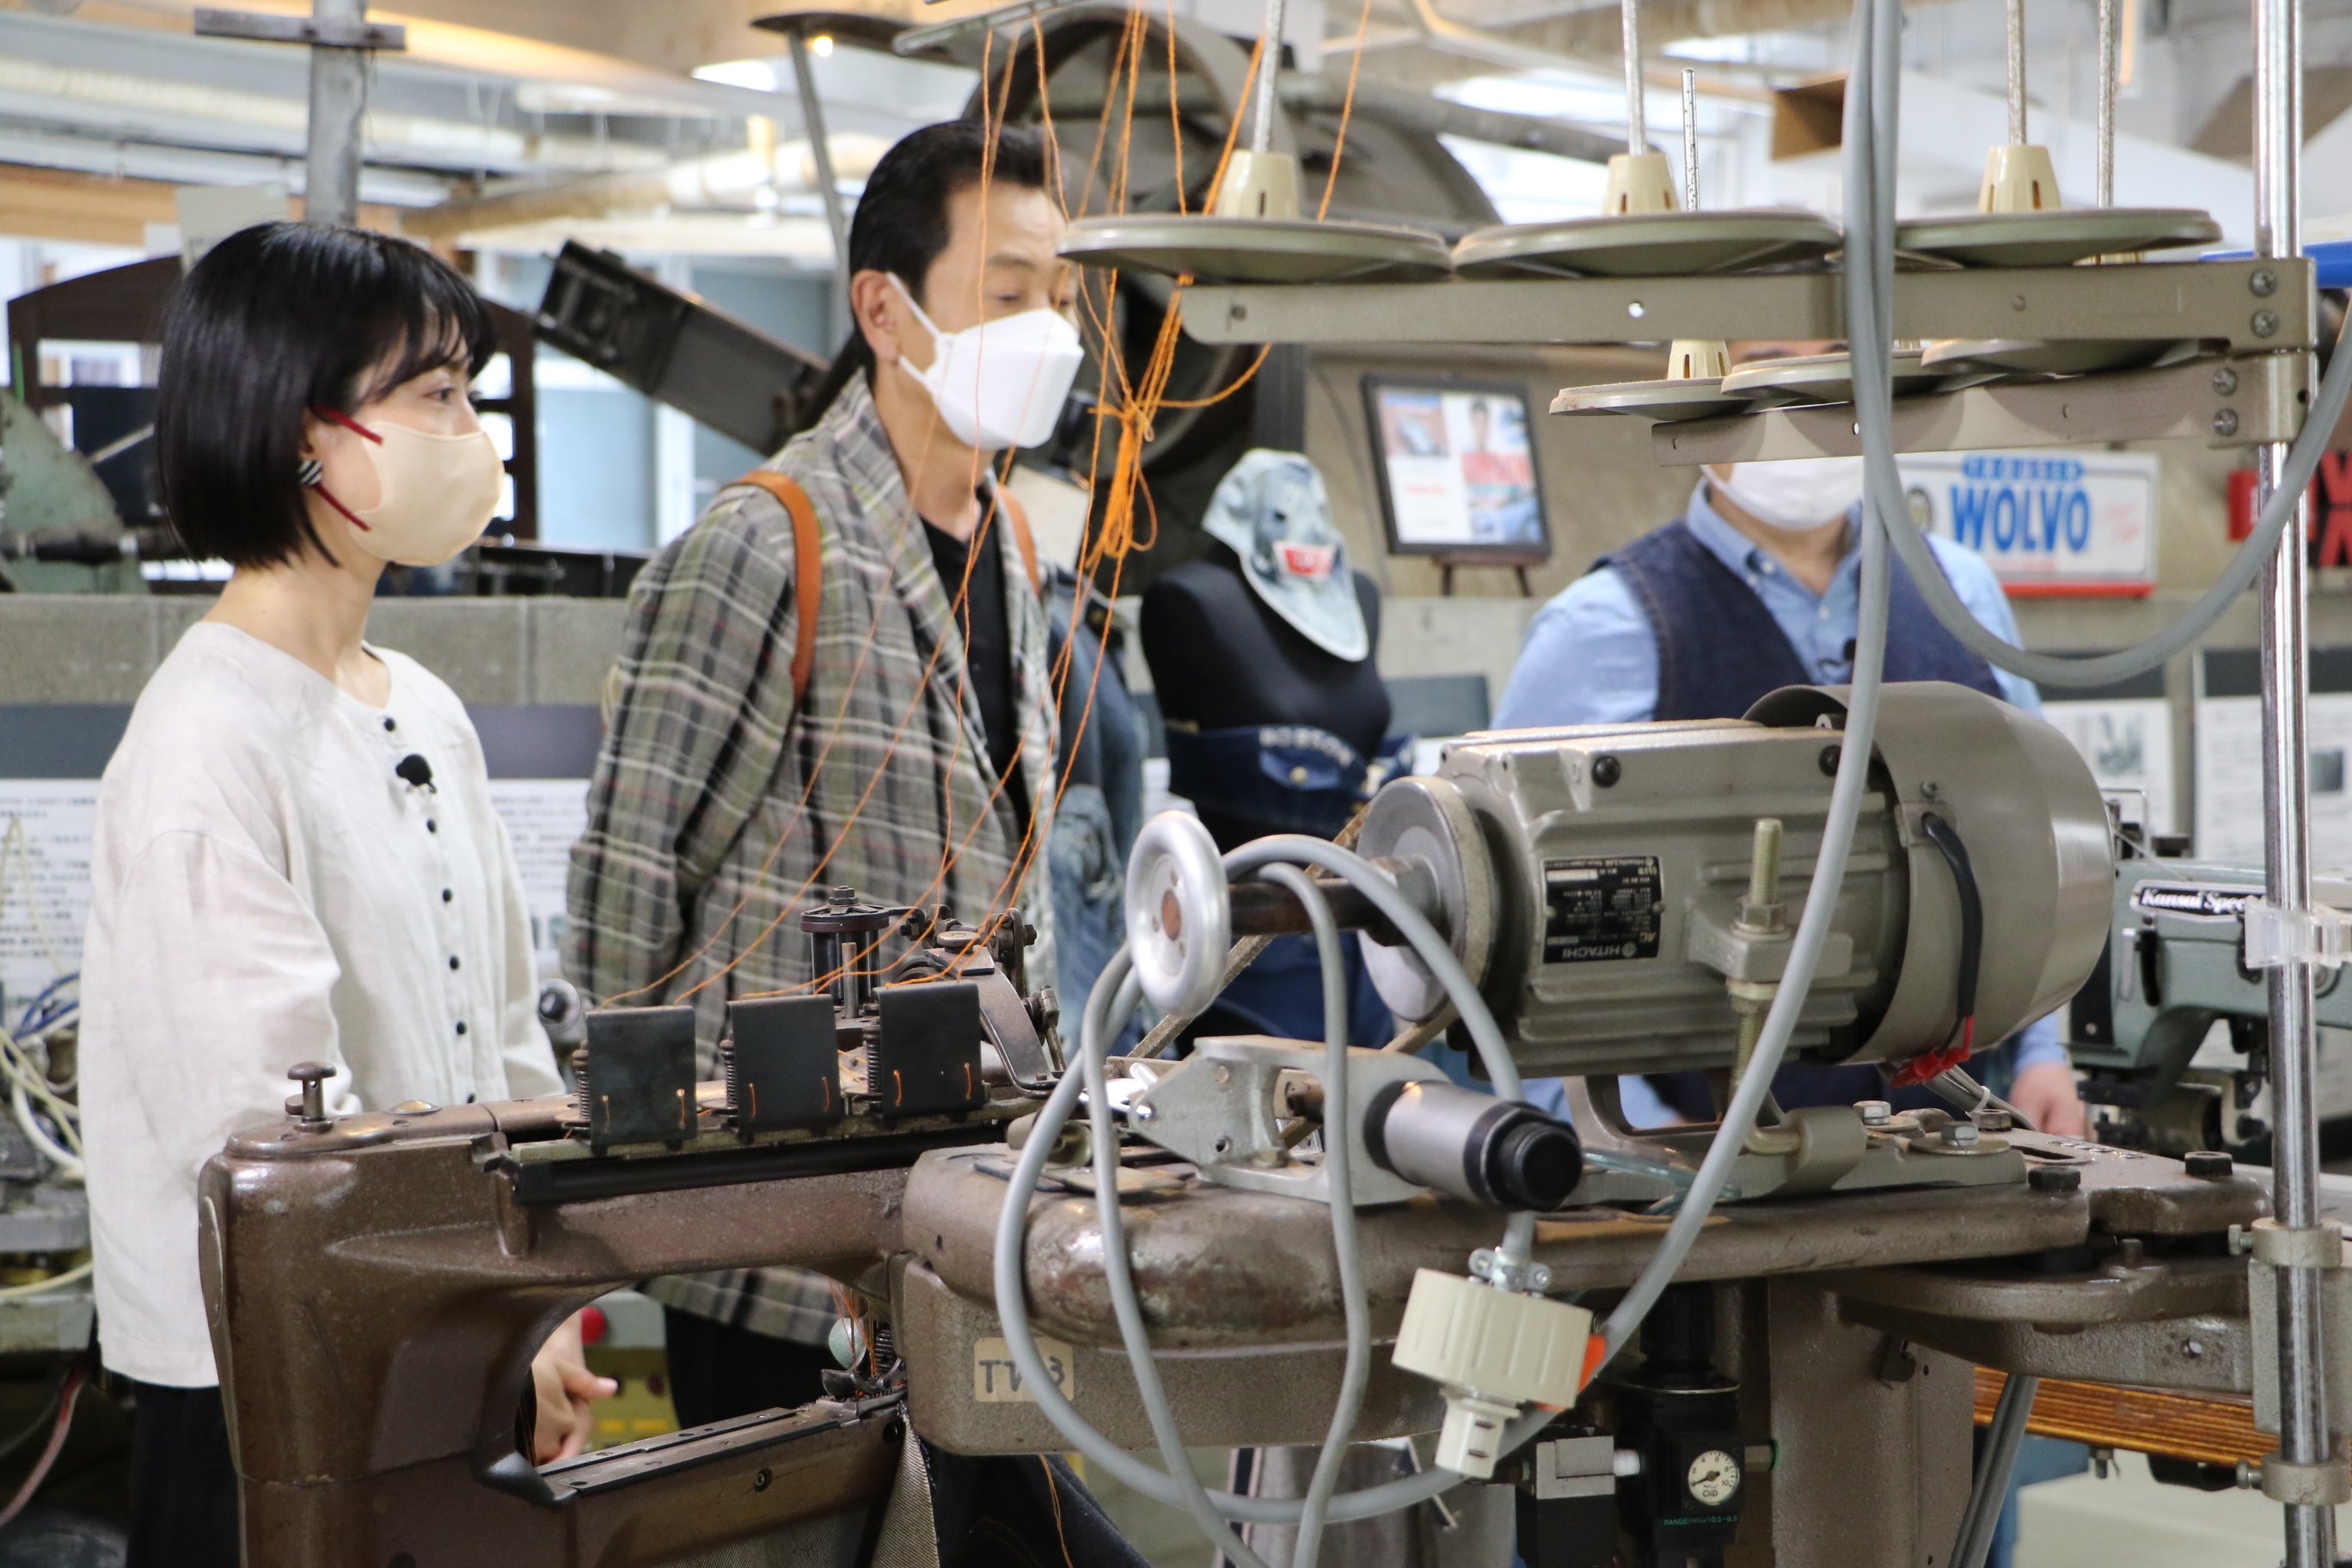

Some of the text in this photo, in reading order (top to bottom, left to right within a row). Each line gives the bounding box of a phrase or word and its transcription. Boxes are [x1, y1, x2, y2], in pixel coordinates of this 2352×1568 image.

[1950, 484, 2091, 553] WOLVO
[2203, 891, 2245, 914] Spec
[1562, 945, 1620, 959] HITACHI
